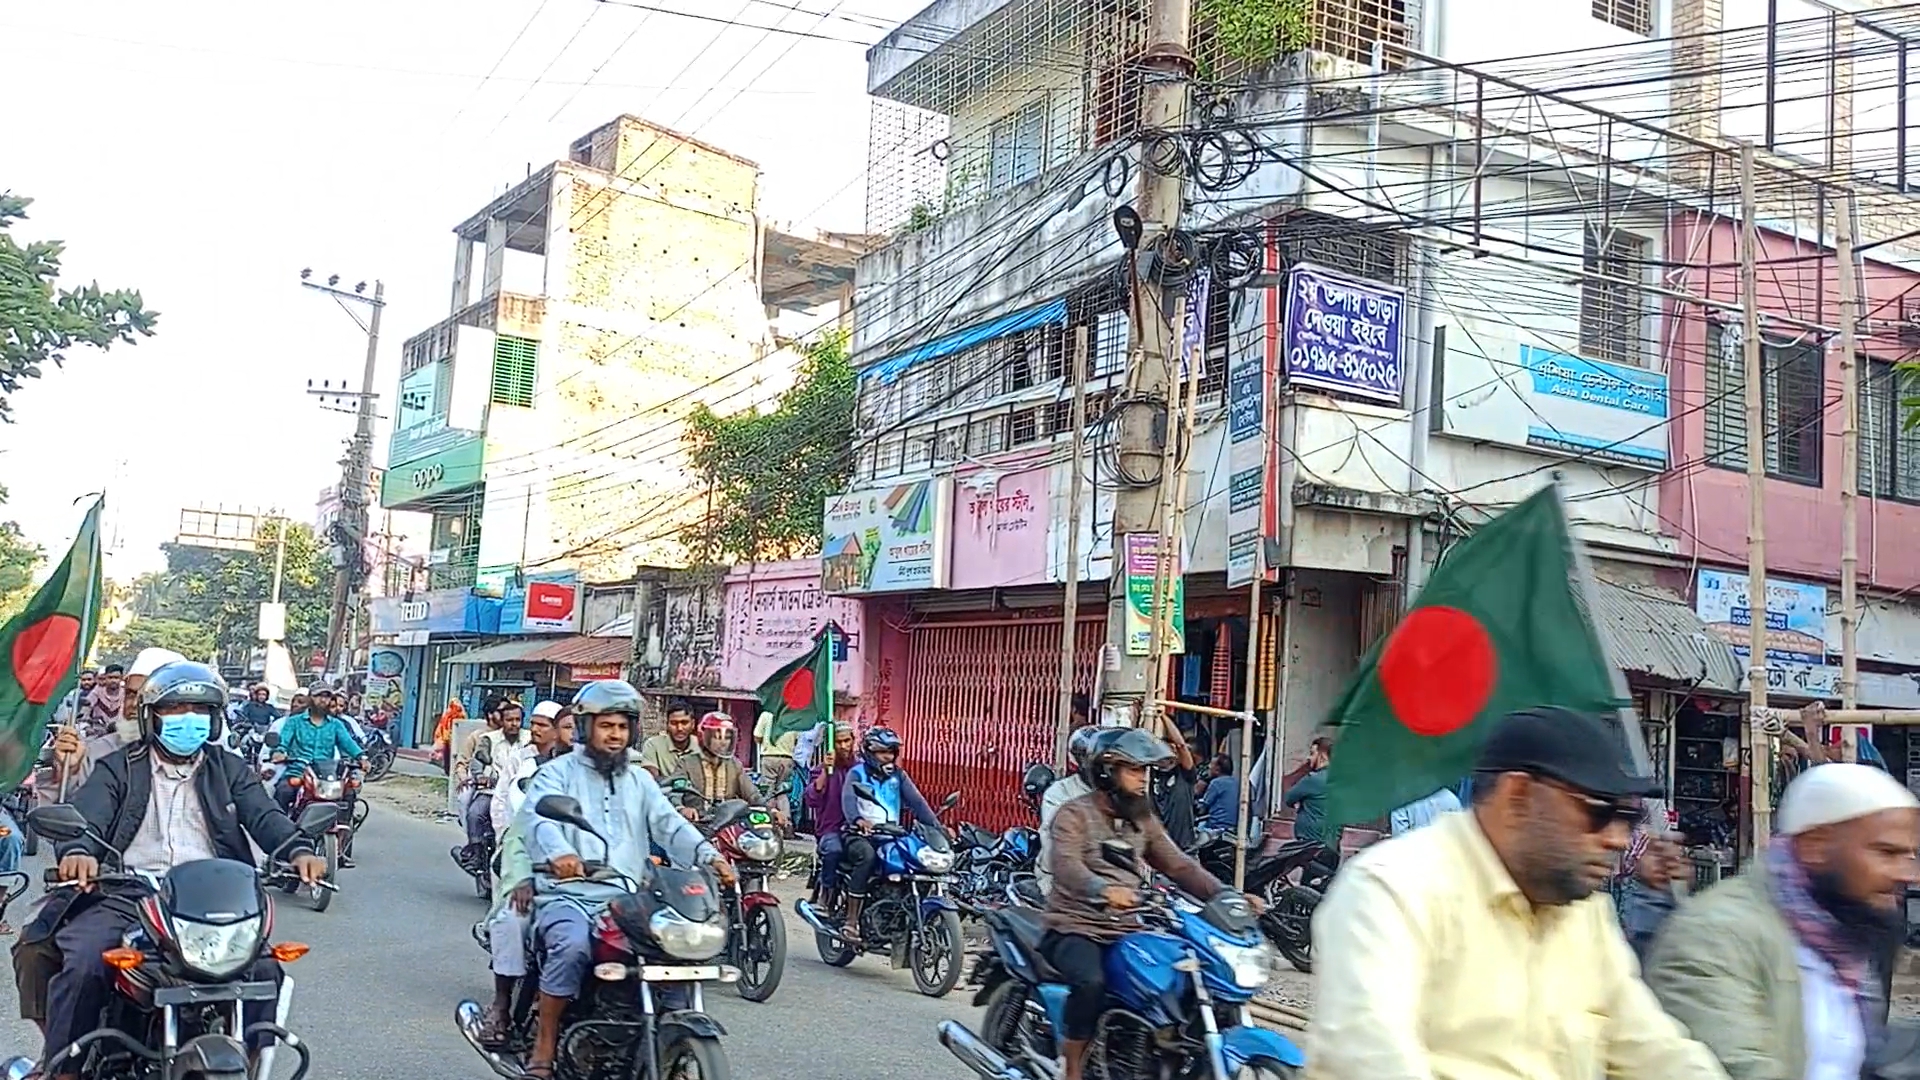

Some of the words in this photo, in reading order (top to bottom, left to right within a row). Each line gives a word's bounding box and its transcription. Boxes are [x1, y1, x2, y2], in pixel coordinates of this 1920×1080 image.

[1298, 278, 1319, 304] ২য়
[1323, 283, 1361, 314] তলায়
[1365, 296, 1398, 325] ভাড়া
[1305, 308, 1347, 339] দেওয়া
[1350, 313, 1389, 349] হইবে
[1551, 384, 1578, 398] Asia
[1581, 390, 1620, 406] Dental
[1622, 398, 1651, 412] Care
